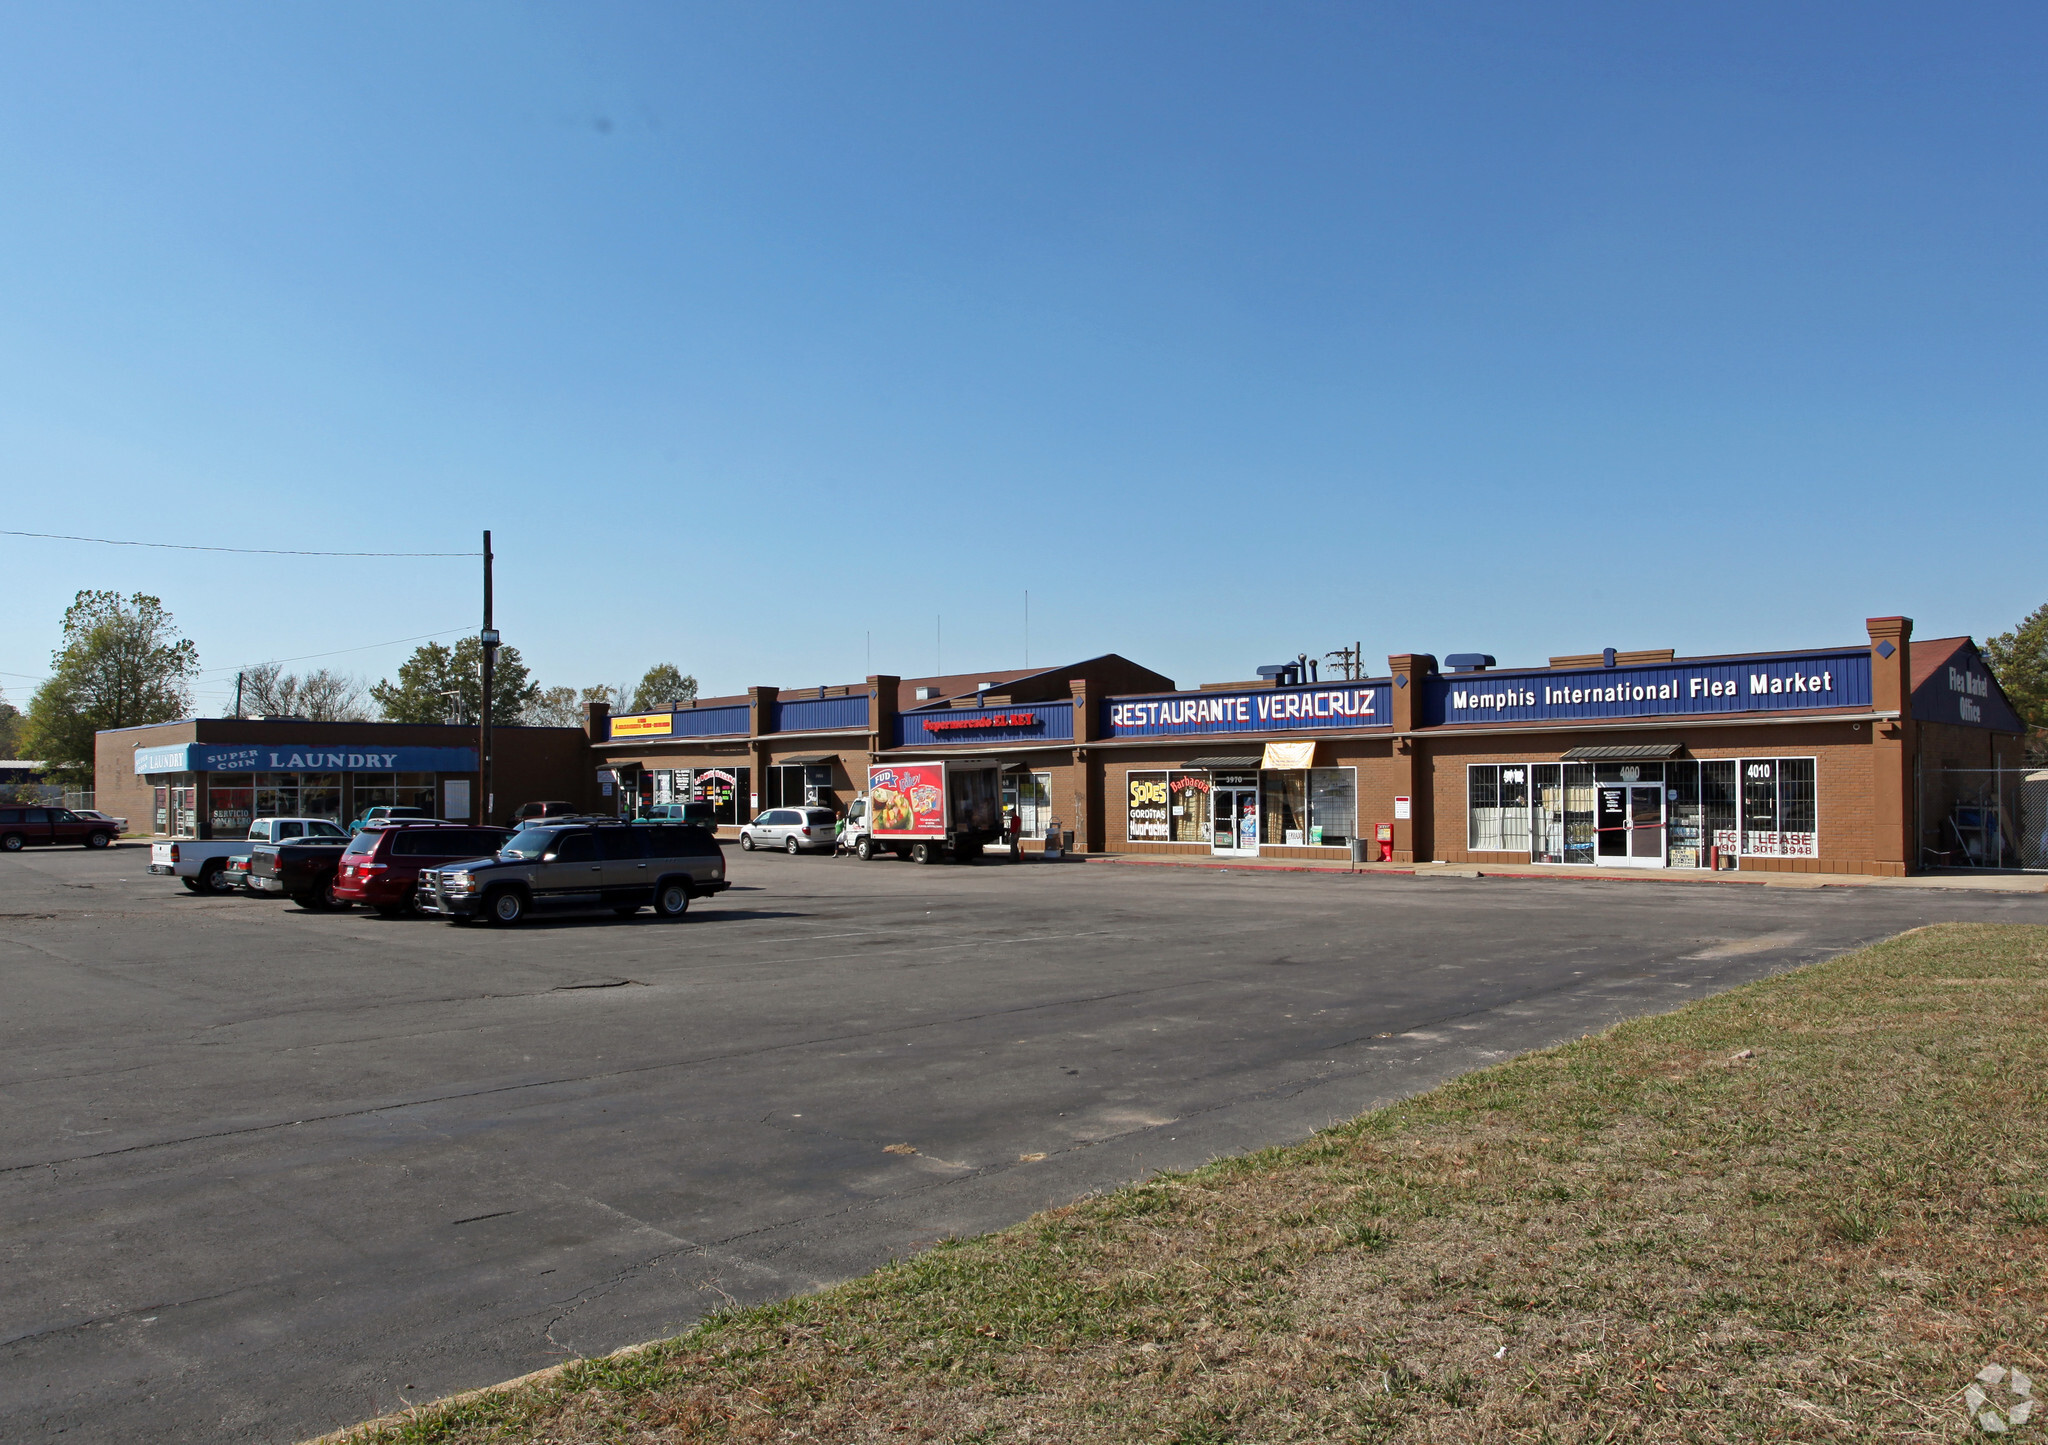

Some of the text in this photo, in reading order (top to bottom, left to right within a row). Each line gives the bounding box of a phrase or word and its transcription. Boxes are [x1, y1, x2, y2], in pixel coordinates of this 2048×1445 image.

[1949, 666, 1988, 698] Flea Market
[1453, 671, 1832, 712] Memphis International Flea Market
[1109, 690, 1375, 727] RESTAURANTE VERACRUZ
[1960, 696, 1980, 723] Office
[922, 713, 1034, 732] Supermercado EL REY
[150, 752, 184, 769] LAUNDRY
[207, 750, 259, 764] SUPER
[217, 758, 256, 770] COIN
[270, 753, 397, 768] LAUNDRY
[875, 771, 891, 784] FUD
[1620, 766, 1640, 779] 4000
[1747, 764, 1770, 778] 4010
[1170, 775, 1209, 793] Barbacoa
[1226, 776, 1242, 784] 3970
[1130, 780, 1167, 808] SOPES
[213, 809, 249, 818] SERVICIO
[1758, 833, 1812, 846] LEASE
